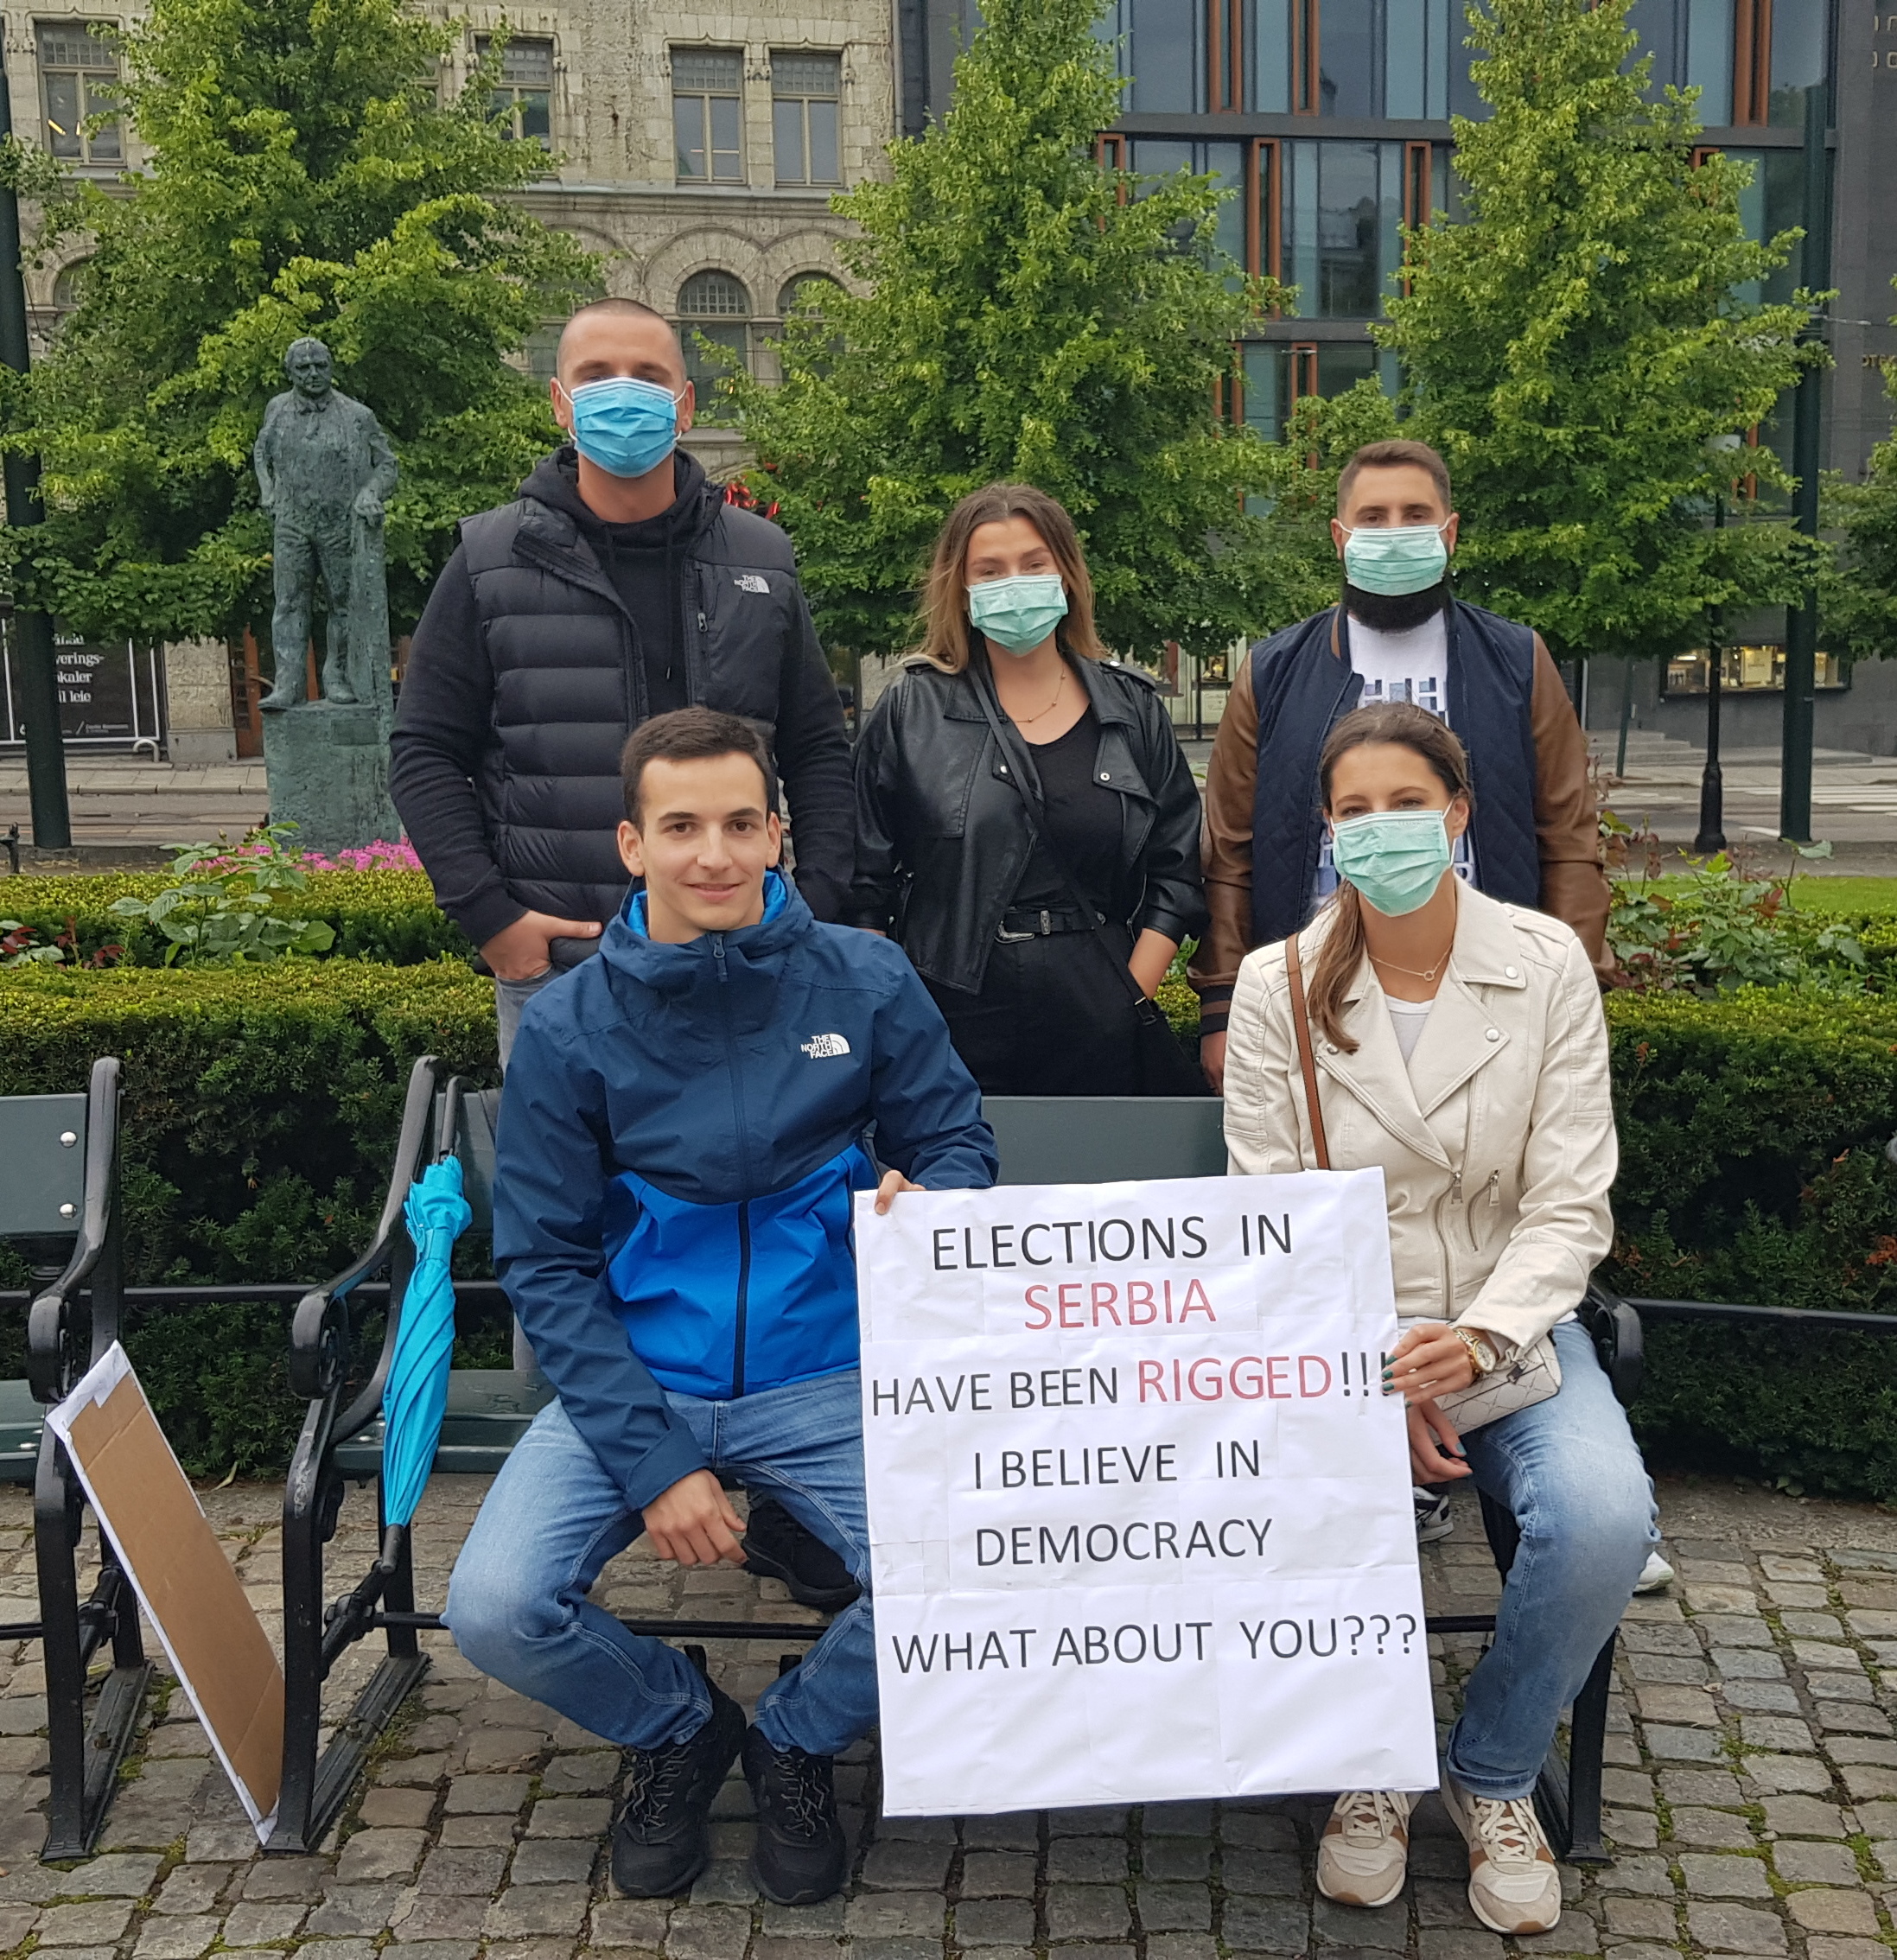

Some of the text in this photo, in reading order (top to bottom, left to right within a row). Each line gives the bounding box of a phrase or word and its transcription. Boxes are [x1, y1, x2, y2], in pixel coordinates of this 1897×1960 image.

[57, 671, 92, 684] kaler
[69, 690, 92, 703] leie
[800, 1040, 832, 1052] NORTH
[810, 1049, 834, 1059] FACE
[812, 1034, 831, 1044] THE
[933, 1212, 1292, 1271] ELECTIONS IN
[1024, 1278, 1217, 1330] SERBIA
[872, 1373, 992, 1416] HAVE
[1010, 1366, 1117, 1409] BEEN
[975, 1439, 1260, 1490] I BELIEVE IN
[977, 1518, 1273, 1567] DEMOCRACY
[891, 1613, 1416, 1674] WHAT ABOUT YOU???
